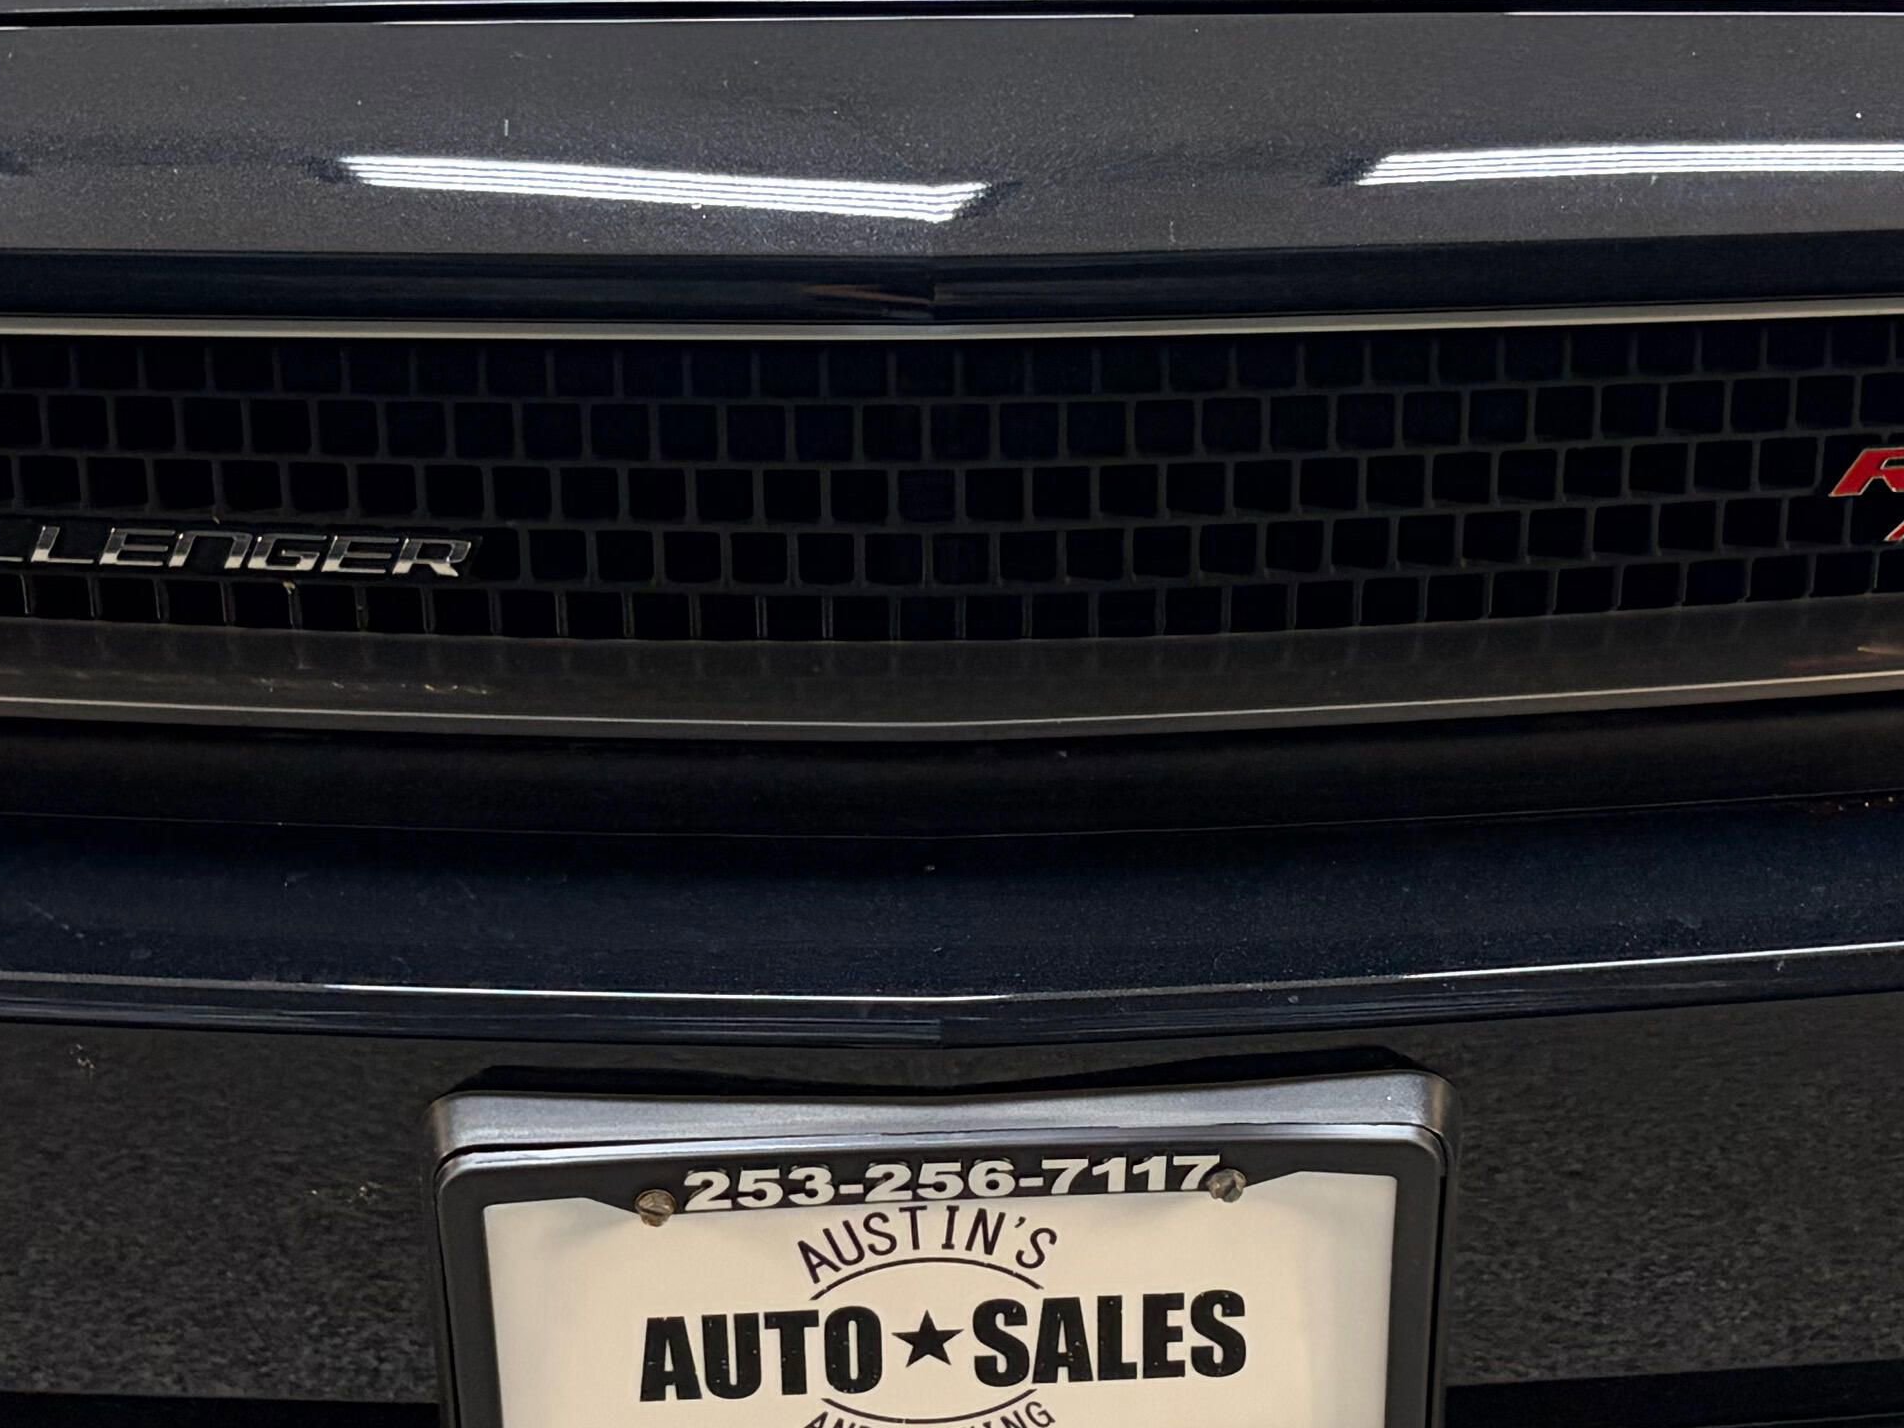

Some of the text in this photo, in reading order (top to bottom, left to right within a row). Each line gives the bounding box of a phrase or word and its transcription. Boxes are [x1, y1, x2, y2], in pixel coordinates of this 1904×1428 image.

[683, 1154, 1221, 1211] 253-256-7117
[796, 1205, 1057, 1284] AUSTIN'S
[639, 1289, 1246, 1402] AUTO SALES
